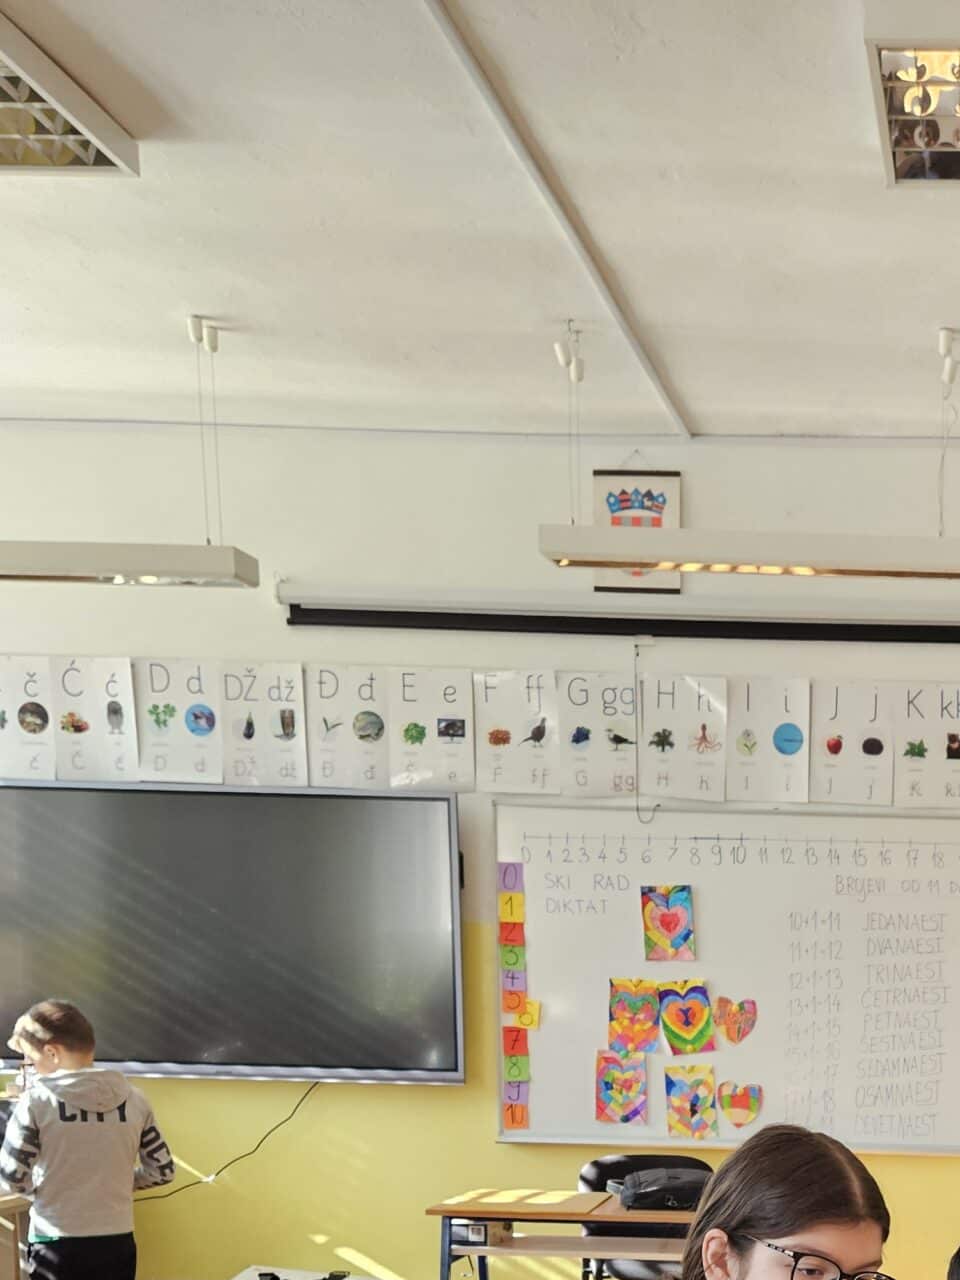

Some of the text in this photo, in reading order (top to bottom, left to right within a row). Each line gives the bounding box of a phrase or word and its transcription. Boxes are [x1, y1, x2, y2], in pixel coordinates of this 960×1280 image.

[61, 659, 85, 698] Ć
[149, 663, 205, 694] D d
[223, 667, 259, 701] DŽ
[317, 669, 339, 700] Đ
[401, 672, 457, 703] E e
[483, 673, 497, 703] F
[567, 676, 590, 706] G
[656, 679, 675, 710] H
[906, 688, 925, 719] K
[592, 872, 631, 892] RAD
[545, 898, 608, 914] DIKTAT
[862, 911, 948, 933] JEDANAEST
